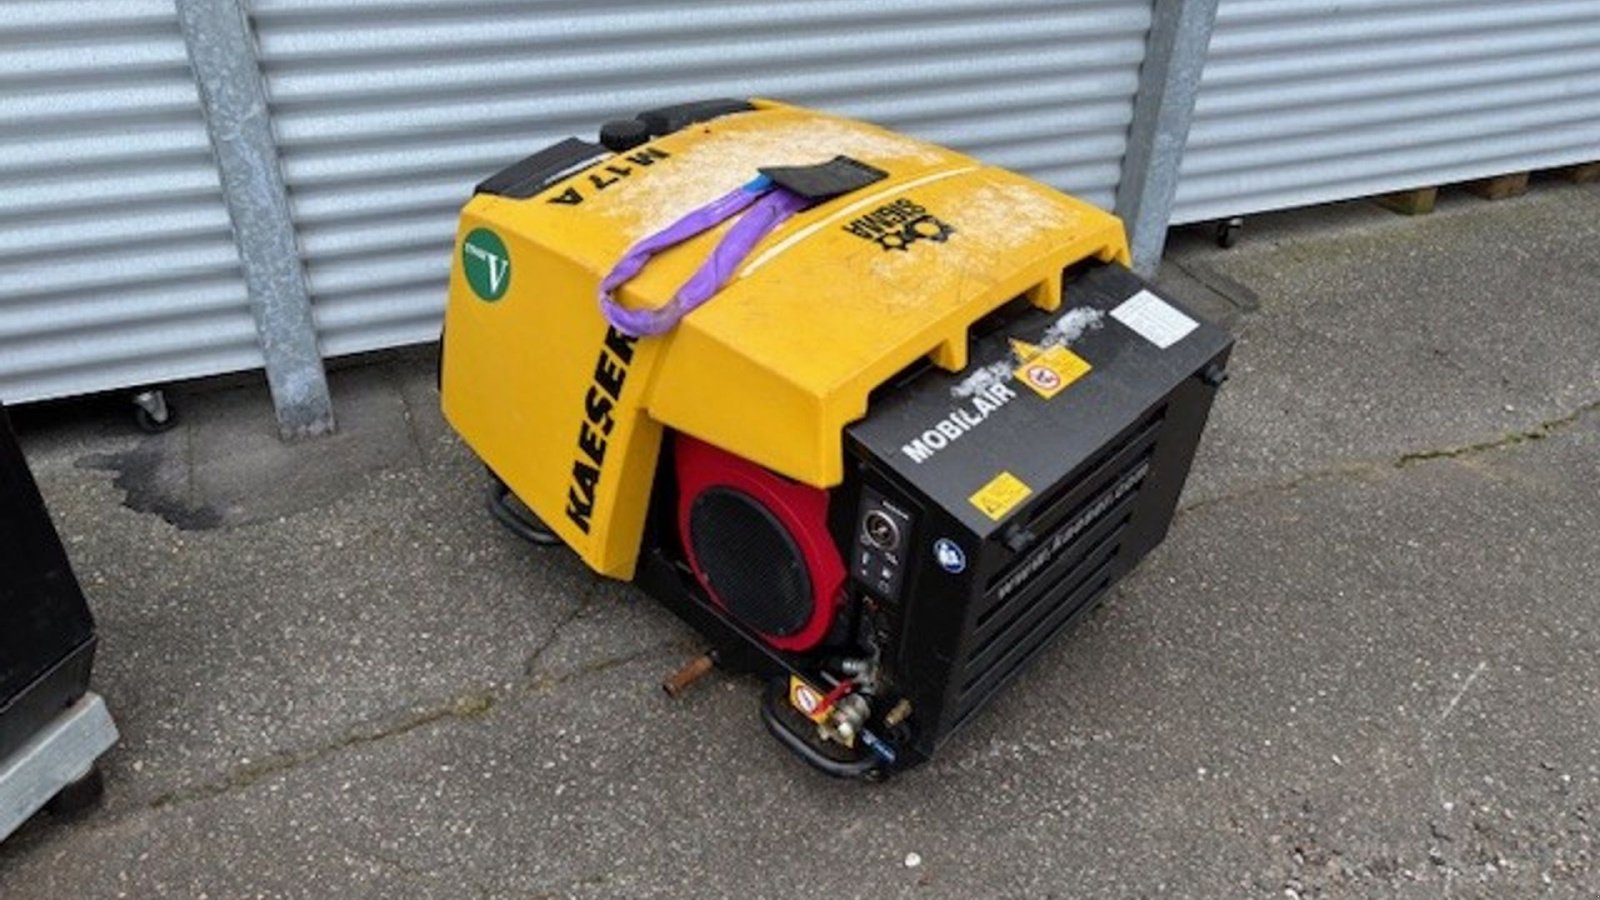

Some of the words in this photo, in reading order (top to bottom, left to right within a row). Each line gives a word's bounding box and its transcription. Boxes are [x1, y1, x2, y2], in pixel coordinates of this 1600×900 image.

[624, 147, 671, 166] M
[587, 165, 632, 190] 17
[545, 187, 584, 206] A
[841, 198, 927, 240] SIGMA
[565, 324, 639, 535] KAESER
[901, 382, 1017, 464] MOBILAIR
